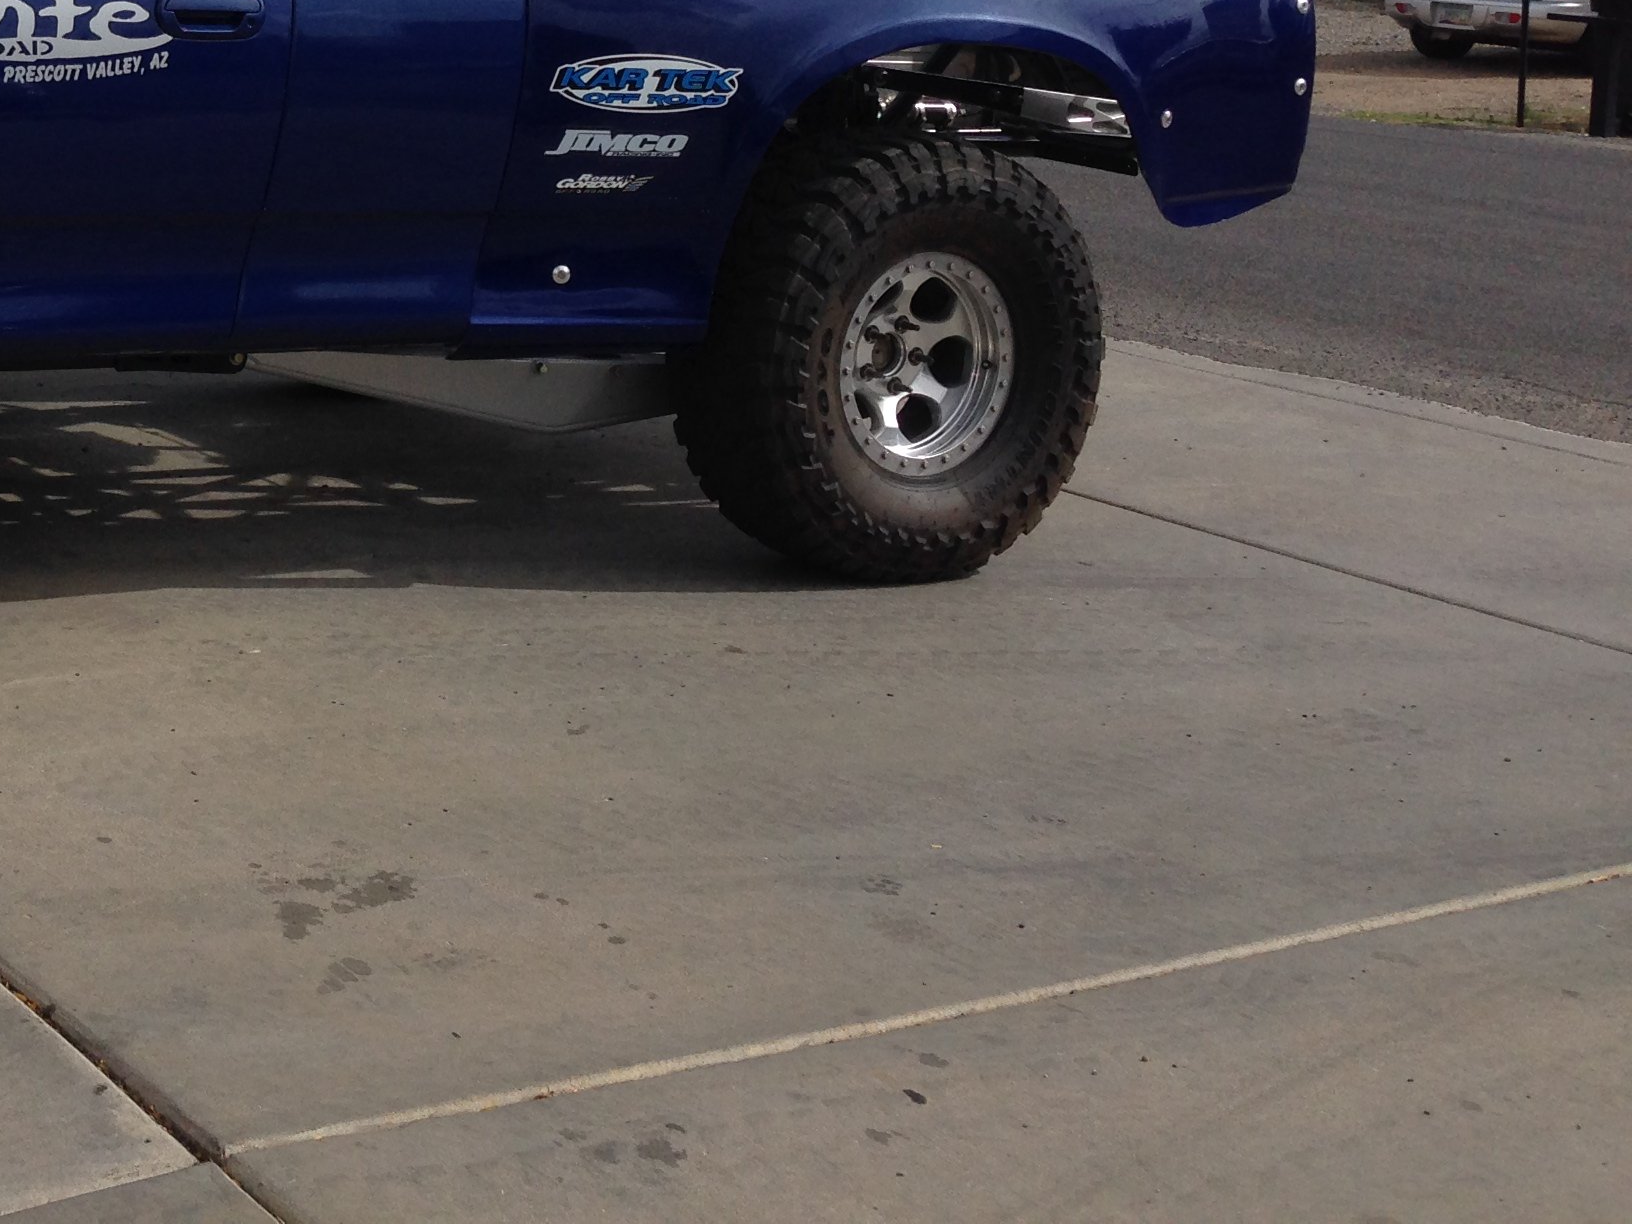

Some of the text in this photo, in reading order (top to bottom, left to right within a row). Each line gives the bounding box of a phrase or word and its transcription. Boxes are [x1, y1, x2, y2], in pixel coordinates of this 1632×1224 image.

[3, 51, 169, 84] PRESCOTT VALLEY, AZ
[556, 66, 741, 93] KAR TEK
[582, 92, 728, 106] OFF ROAD
[544, 129, 690, 155] JIMCO
